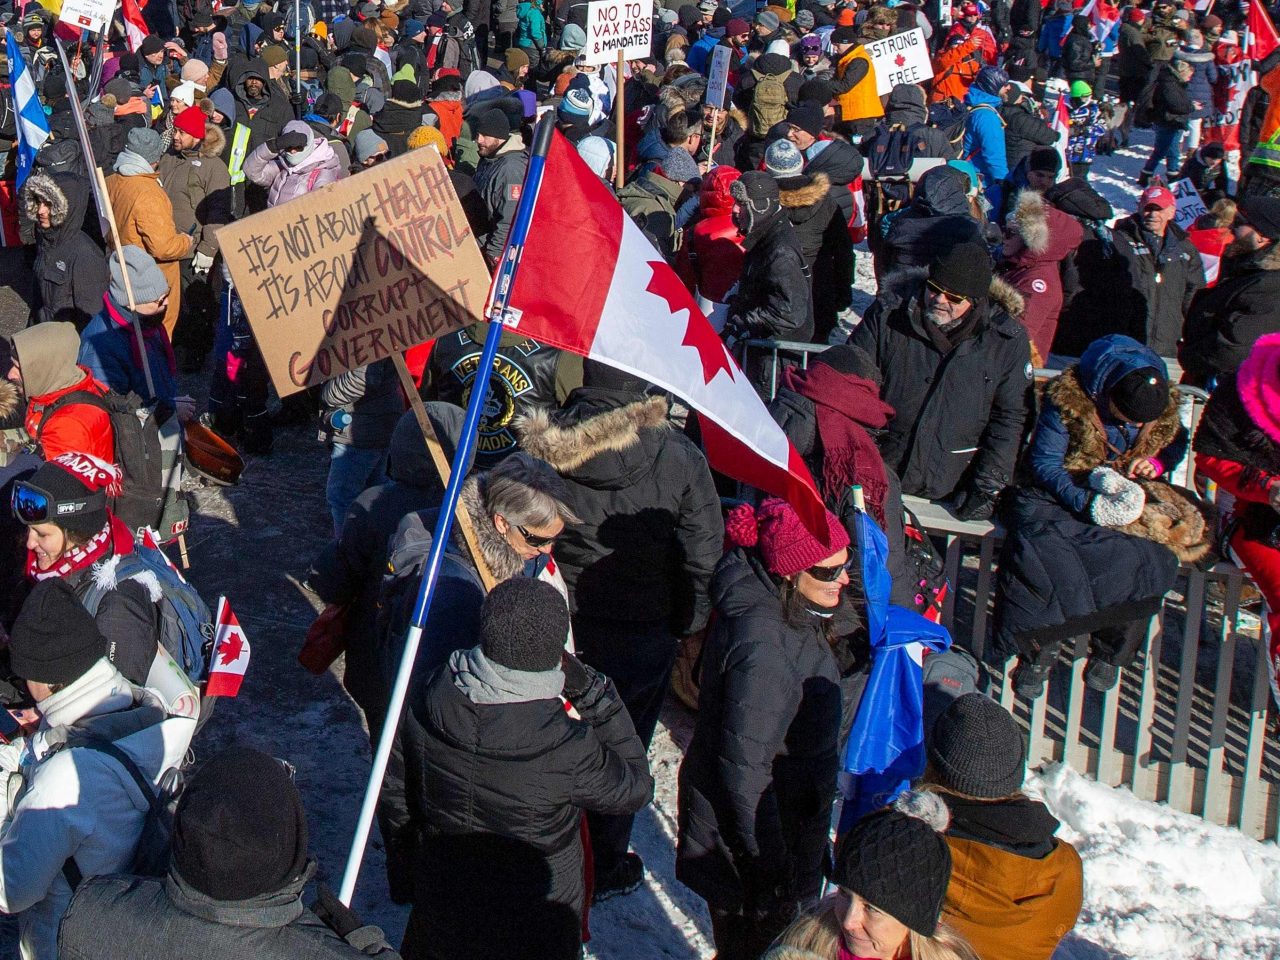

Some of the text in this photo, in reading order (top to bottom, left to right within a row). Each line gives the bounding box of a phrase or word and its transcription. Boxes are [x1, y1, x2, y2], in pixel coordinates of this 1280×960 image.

[598, 3, 641, 22] NO TO
[593, 17, 651, 38] VAX PASS
[594, 33, 649, 54] & MANDATES
[873, 32, 918, 58] STRONG
[888, 66, 920, 87] FREE
[239, 162, 455, 276] IT'S NOT ABOUT HEALTH
[257, 207, 471, 321] IT'S ABOUT CONTROL
[322, 273, 430, 336] CORRUPT
[289, 279, 472, 388] GOVERNMENT
[455, 356, 528, 392] VETRANS
[480, 434, 513, 450] NADA
